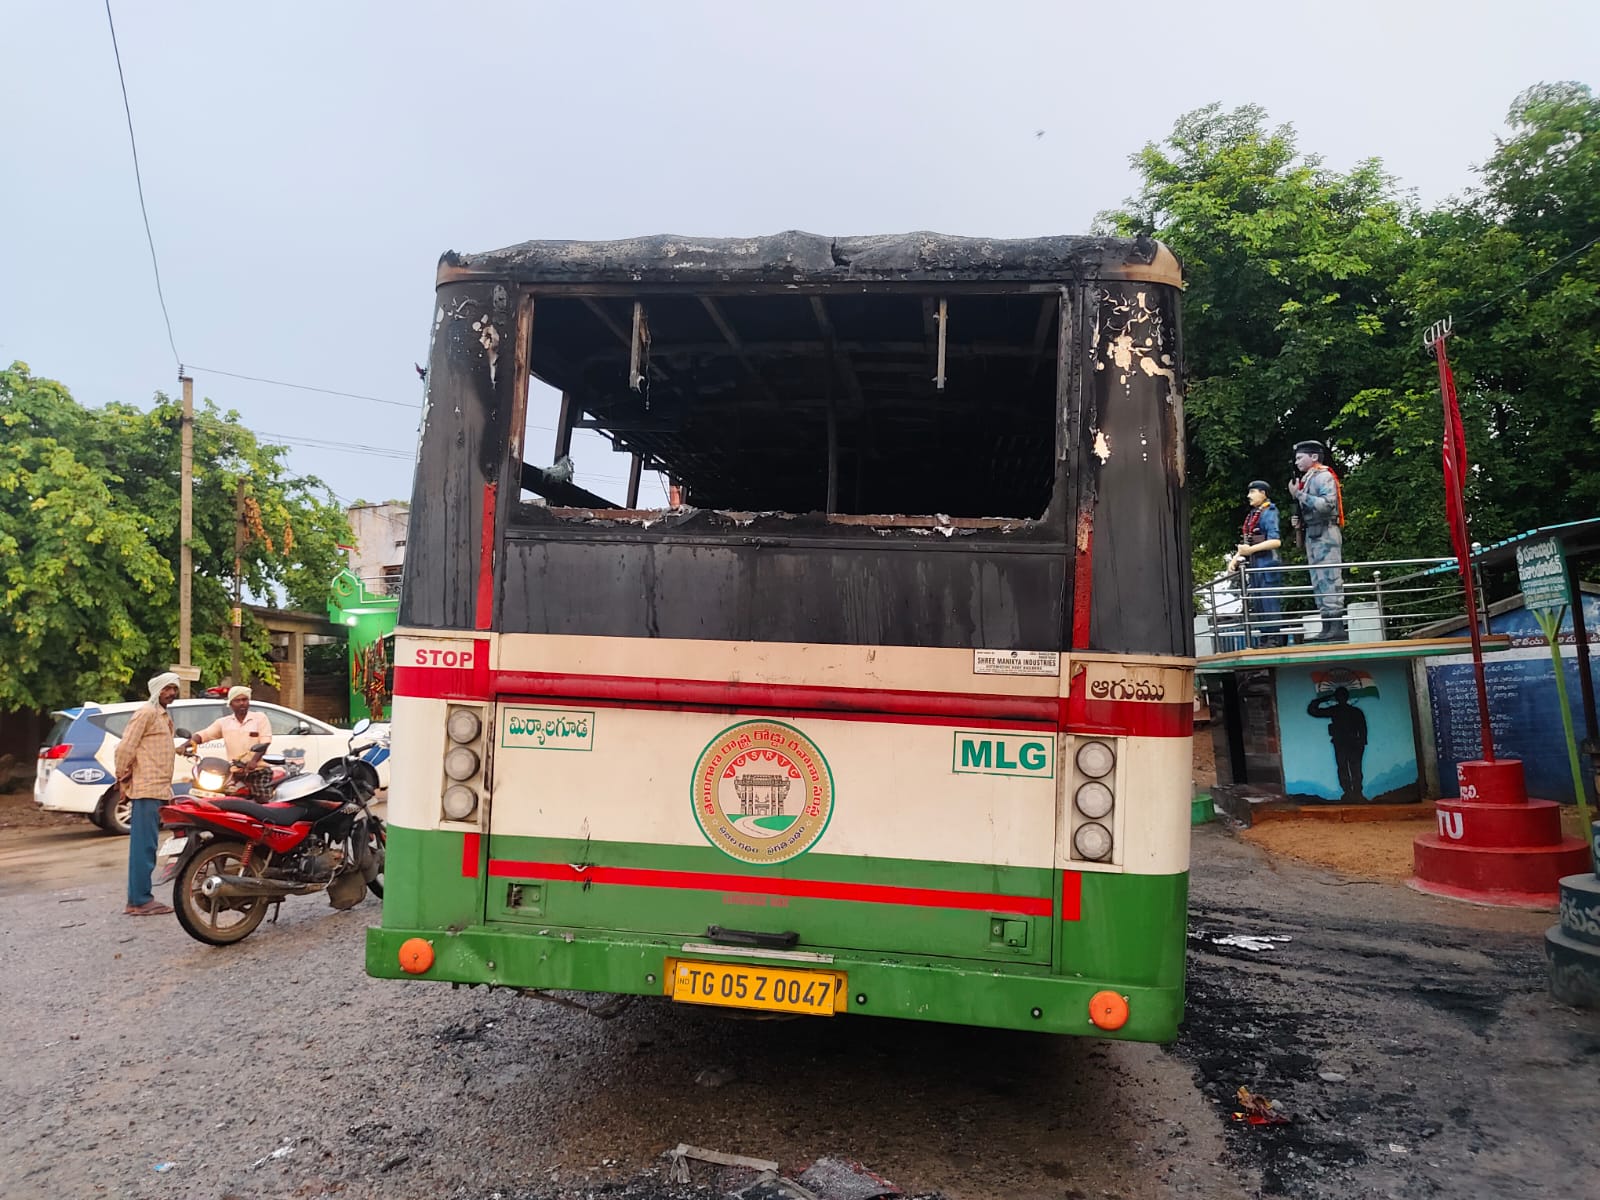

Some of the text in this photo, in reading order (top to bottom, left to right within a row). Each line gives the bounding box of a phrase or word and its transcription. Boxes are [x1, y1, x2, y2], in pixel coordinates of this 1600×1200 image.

[415, 649, 473, 668] STOP
[977, 657, 1056, 667] SHREE MANIKYA INDUSTRIES
[1090, 678, 1165, 702] ఆగుము
[509, 716, 588, 746] మిర్యాలగూడ
[961, 739, 1047, 770] MLG
[703, 755, 723, 815] తెలంగాణ
[690, 970, 715, 995] TG
[721, 973, 748, 999] 05
[754, 976, 768, 1001] Z
[773, 979, 831, 1007] 0047
